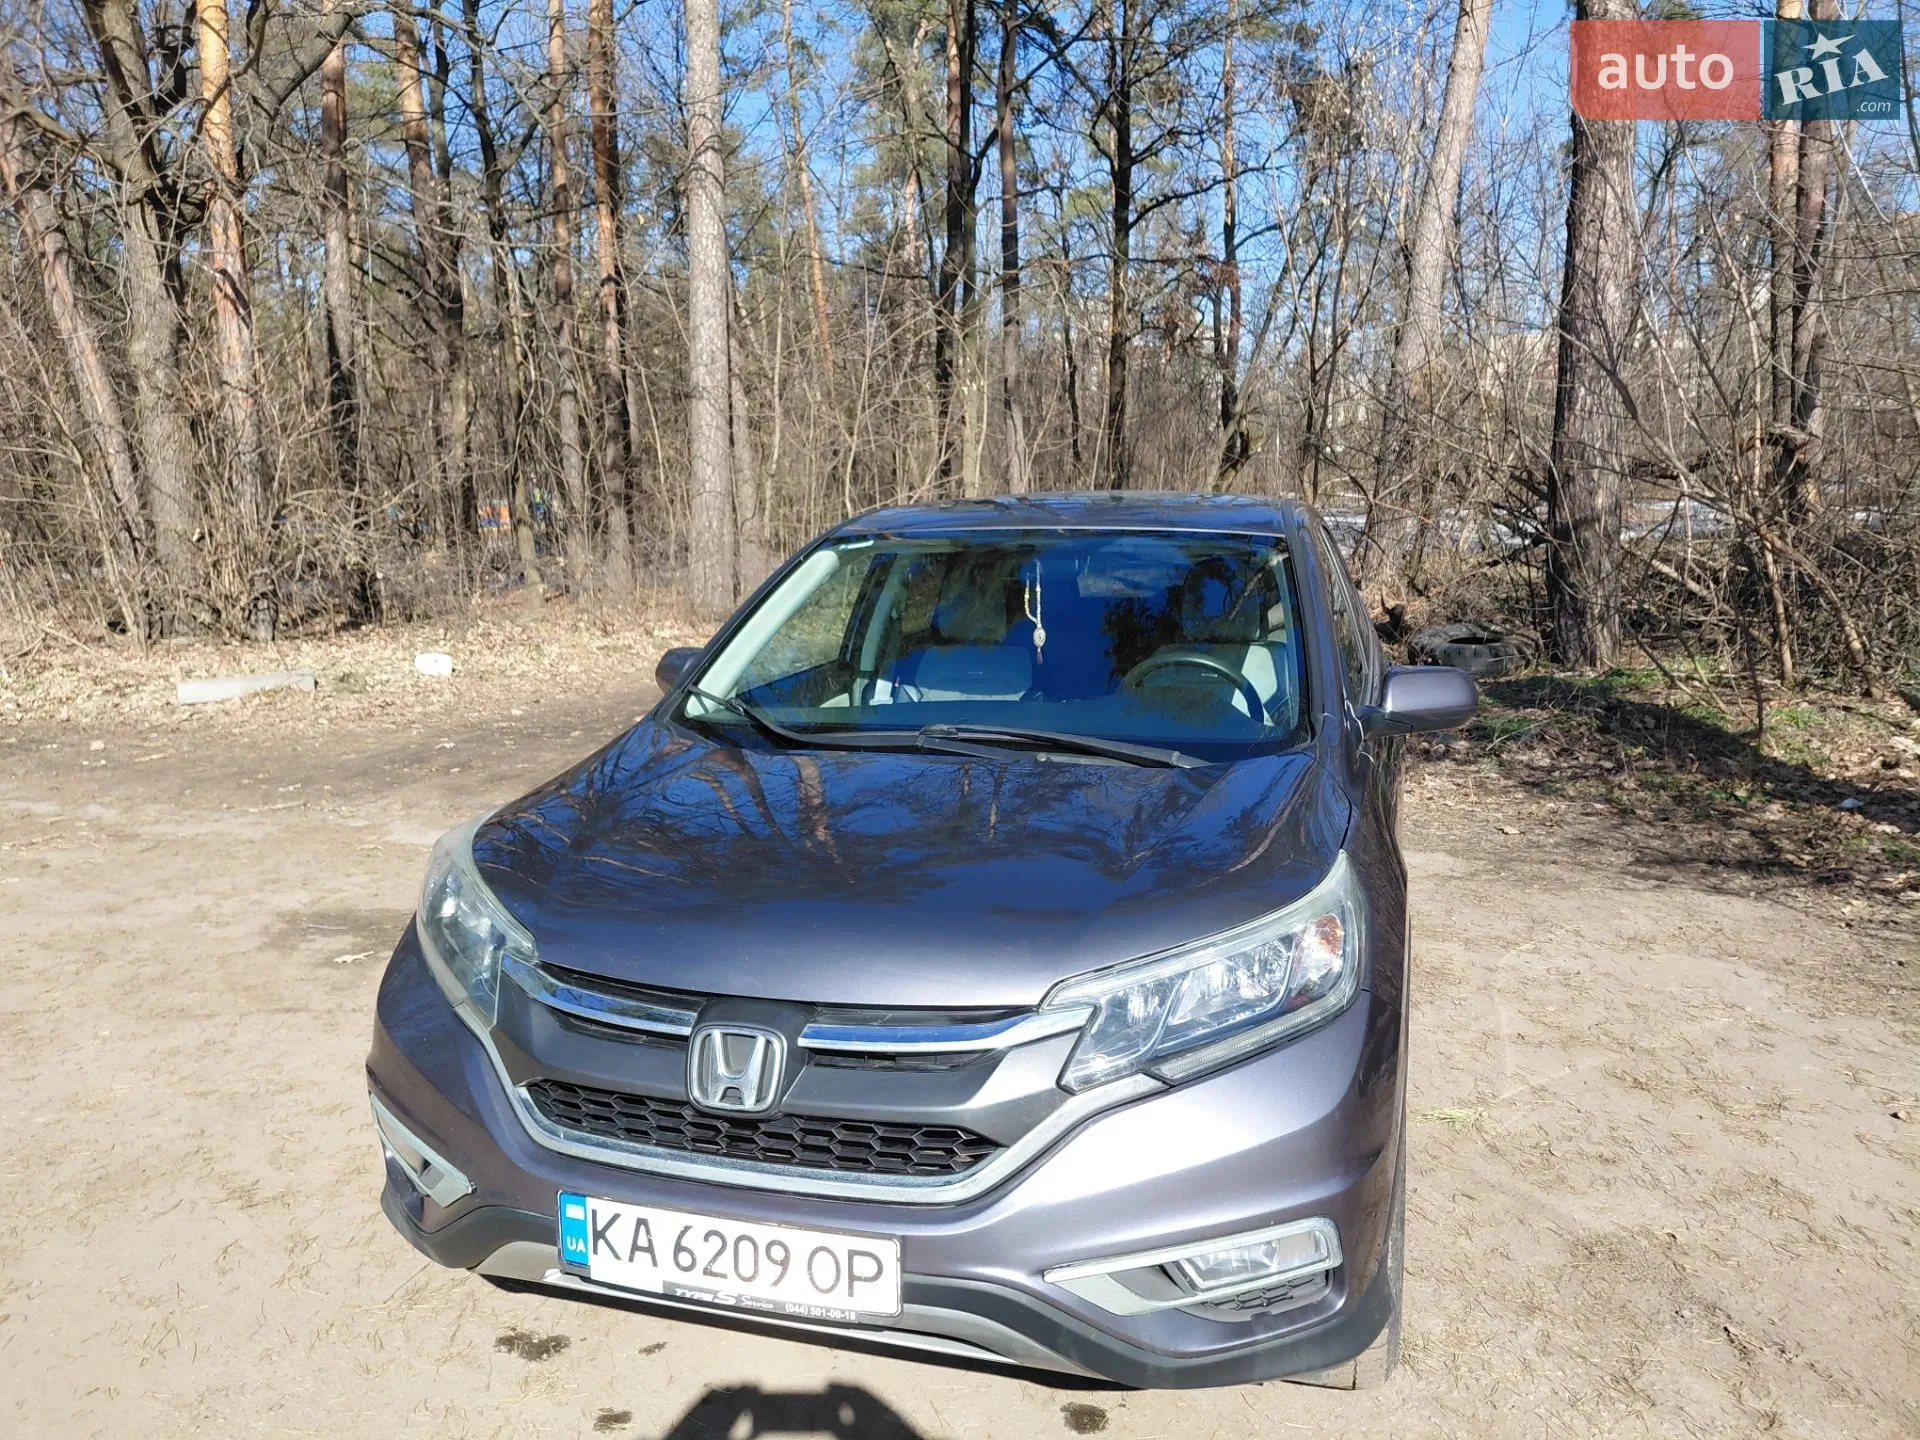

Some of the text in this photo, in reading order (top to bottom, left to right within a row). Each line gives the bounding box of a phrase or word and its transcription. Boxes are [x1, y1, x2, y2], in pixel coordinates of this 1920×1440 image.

[566, 1235, 587, 1254] UA
[591, 1208, 885, 1298] KA 6209 OP
[784, 1302, 809, 1316] (044)
